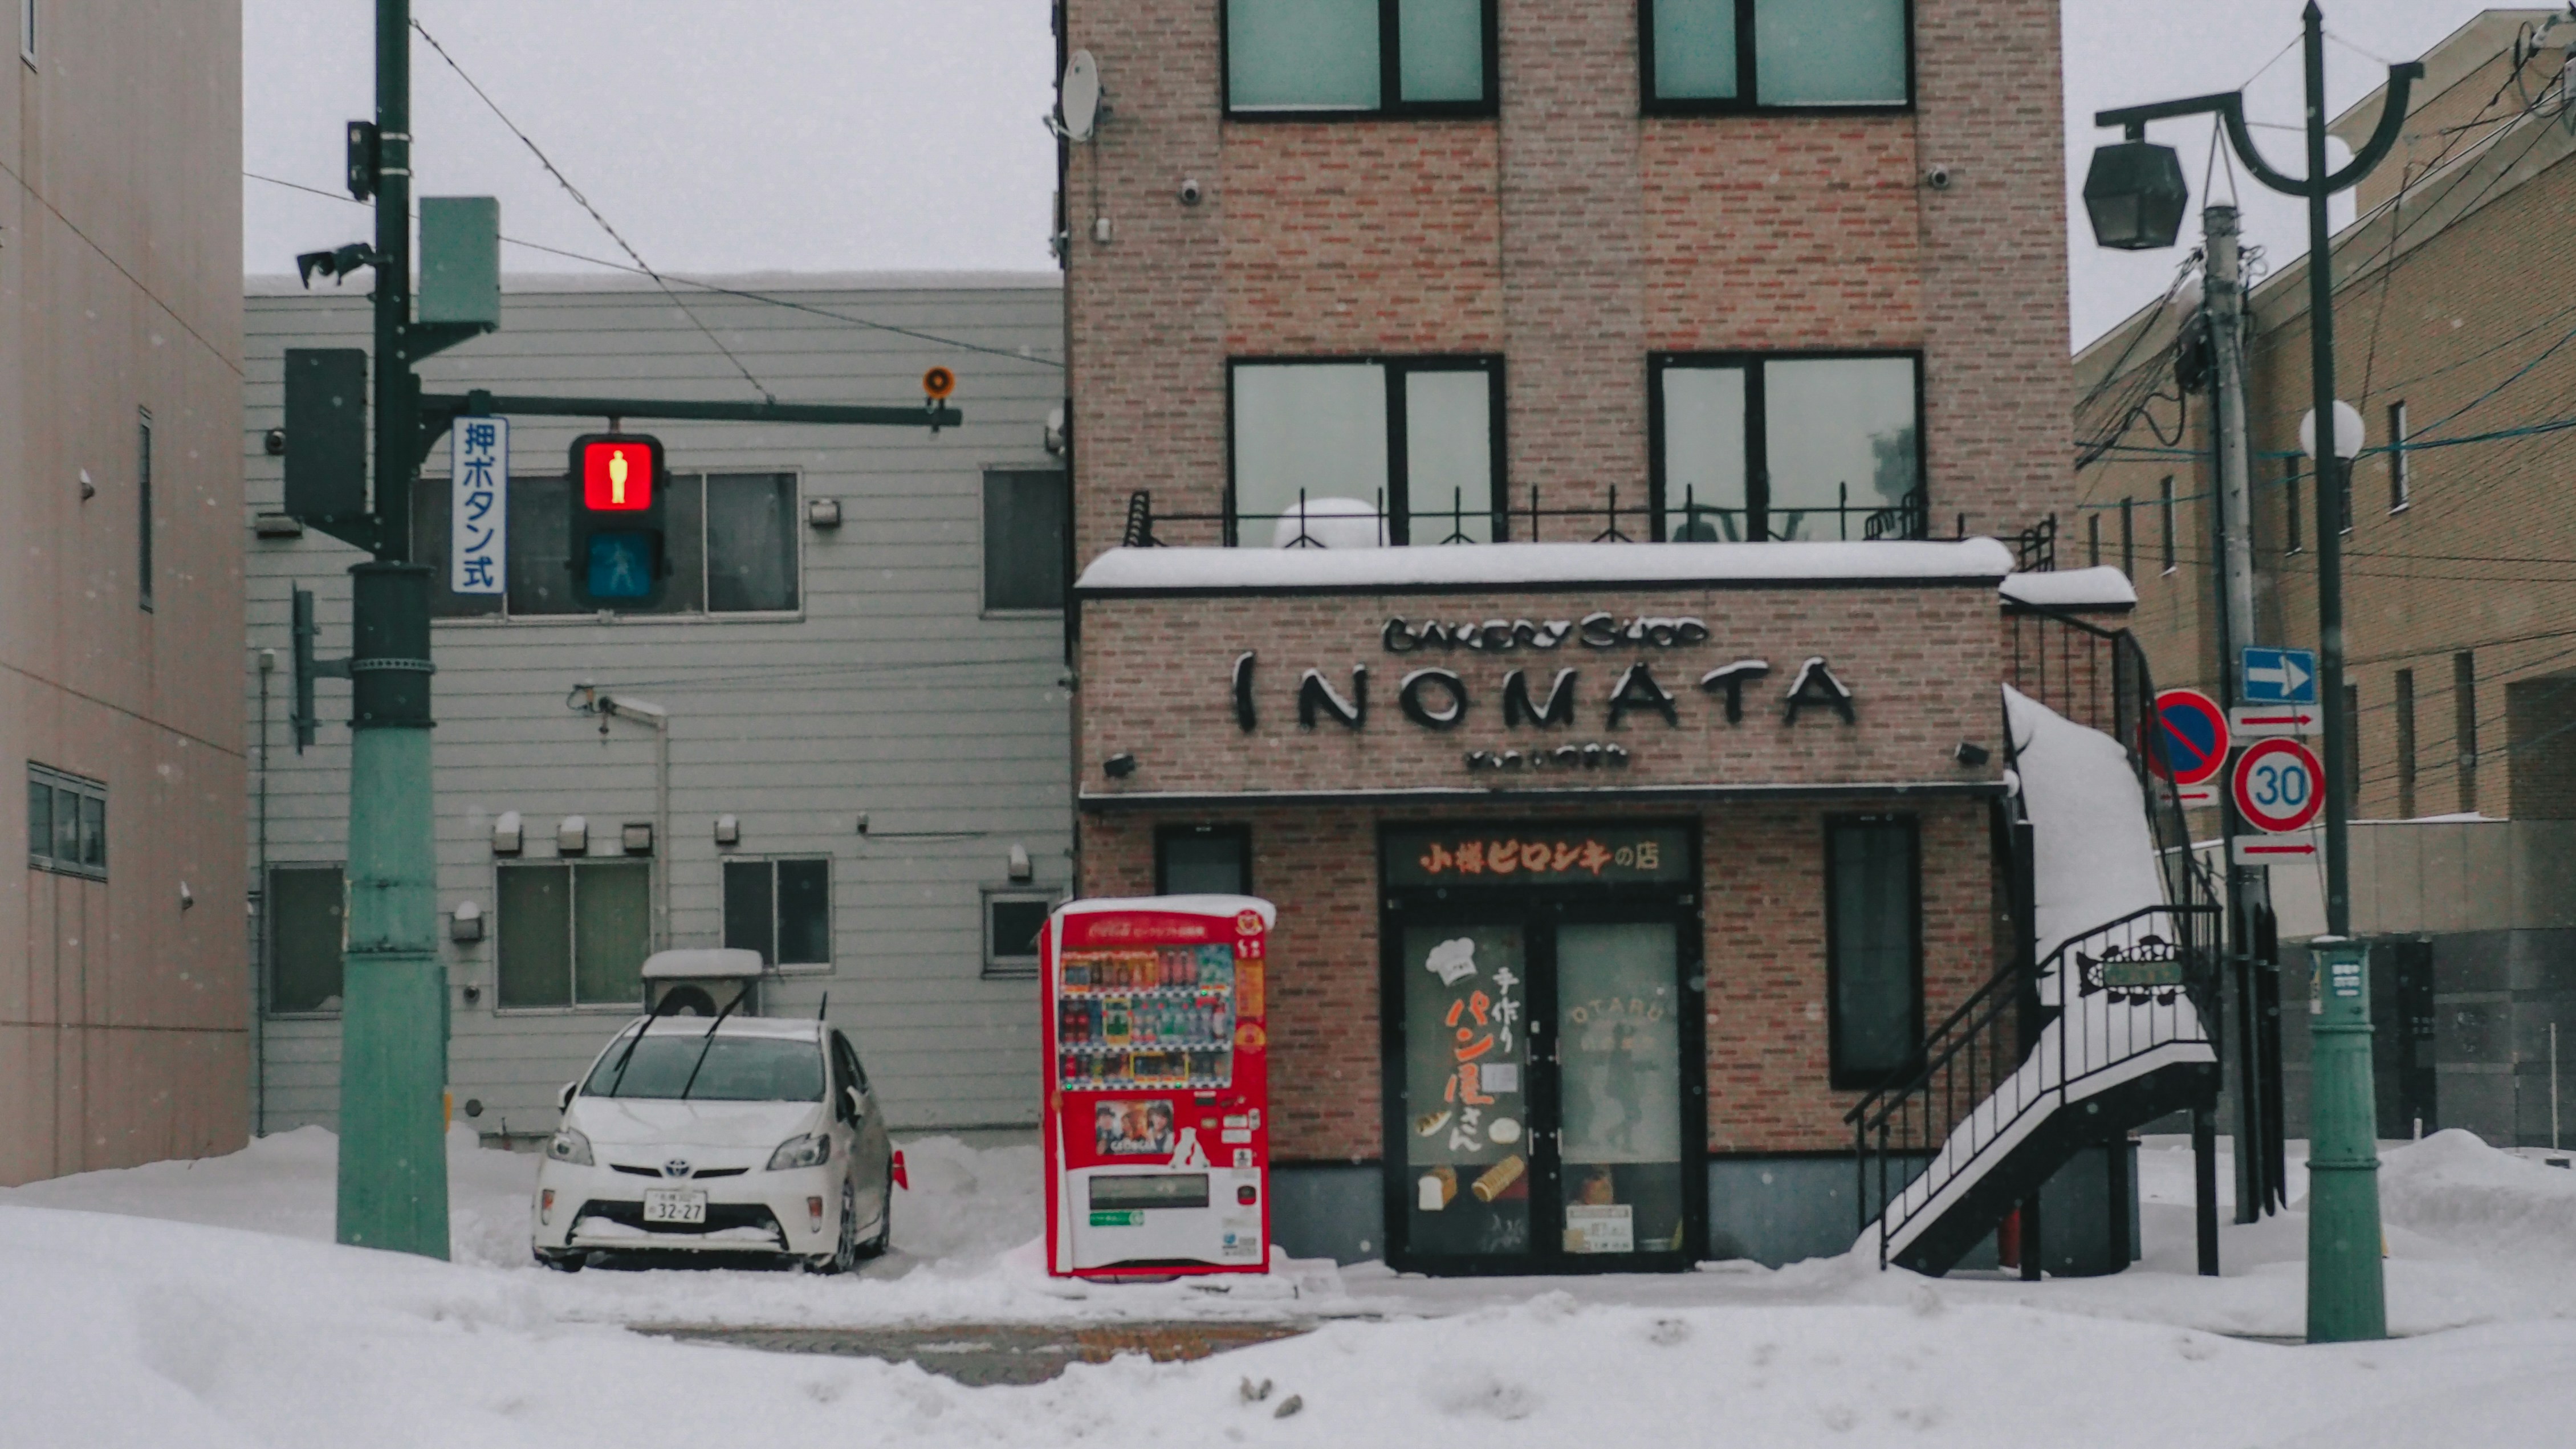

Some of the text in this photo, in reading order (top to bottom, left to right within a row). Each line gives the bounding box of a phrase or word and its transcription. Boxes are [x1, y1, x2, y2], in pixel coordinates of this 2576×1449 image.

[463, 423, 495, 587] 押ボタン式
[1232, 650, 1856, 733] INOMATA
[2256, 765, 2306, 805] 30
[1492, 967, 1521, 1054] 手作り
[1572, 997, 1663, 1023] OTARU
[1444, 990, 1495, 1151] パン屋さん
[658, 1203, 702, 1220] 32-27
